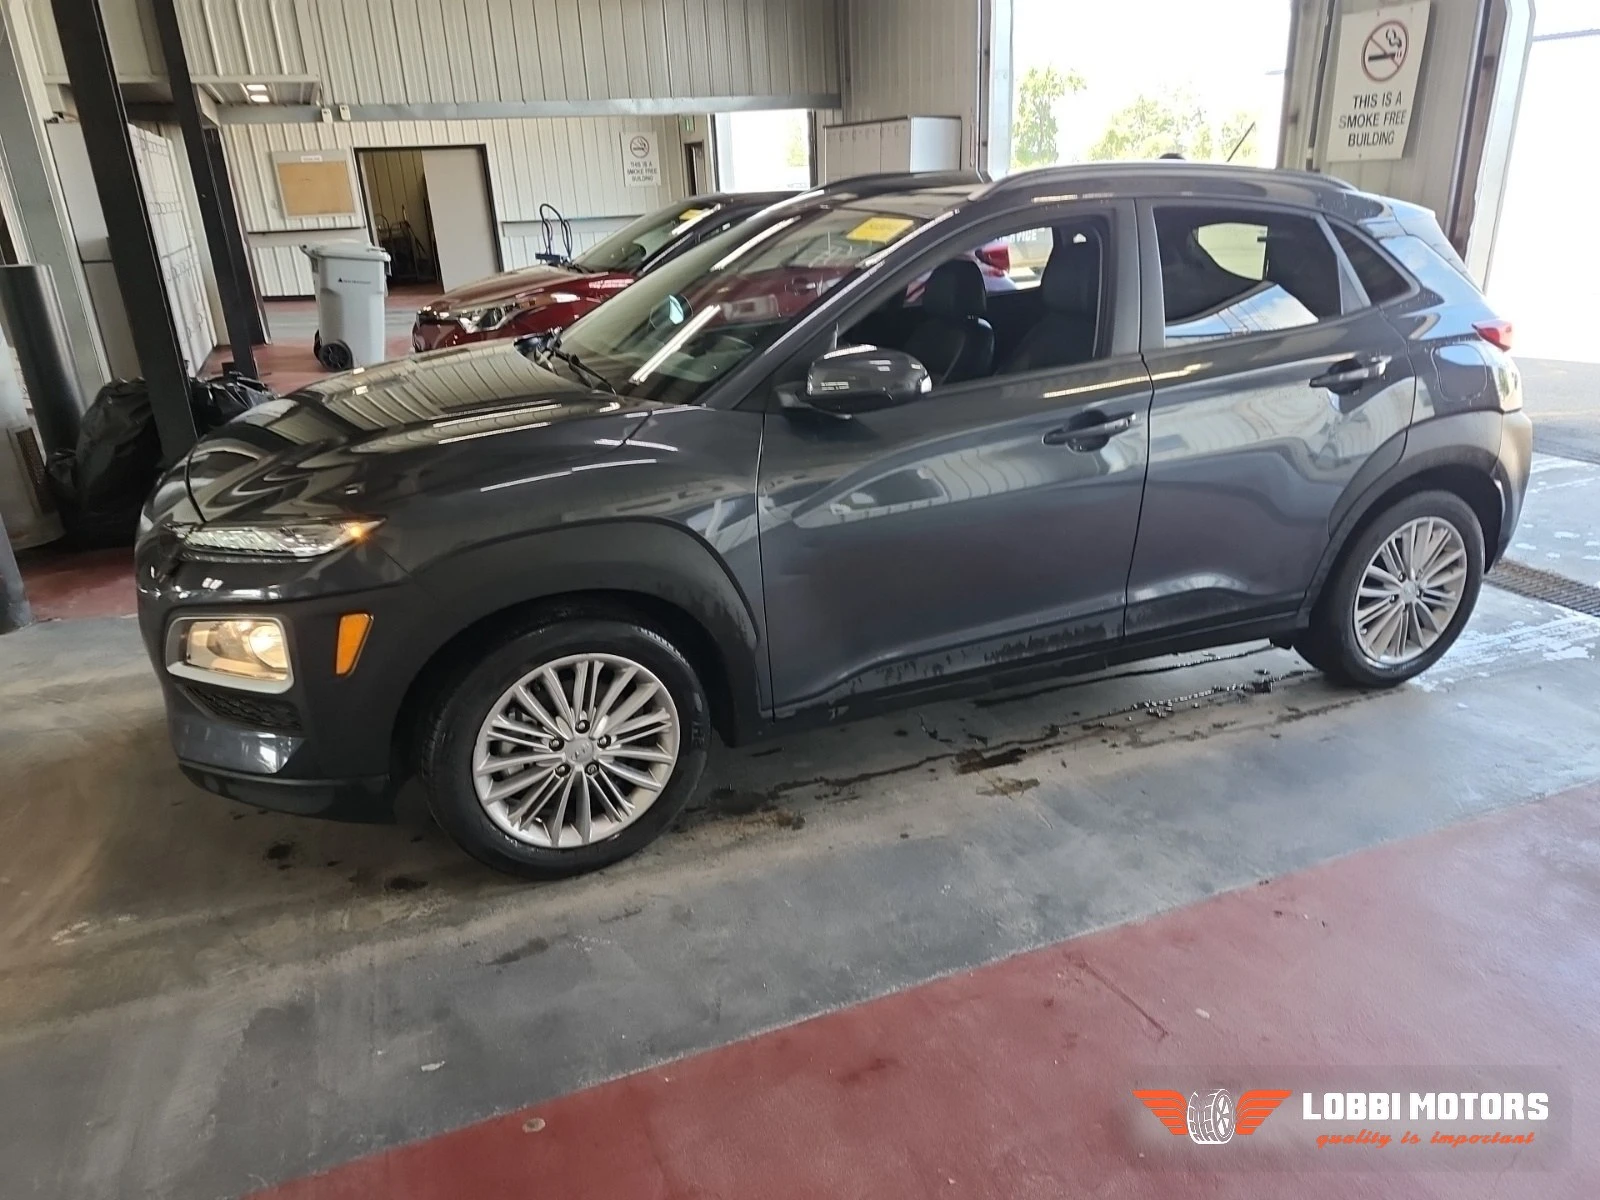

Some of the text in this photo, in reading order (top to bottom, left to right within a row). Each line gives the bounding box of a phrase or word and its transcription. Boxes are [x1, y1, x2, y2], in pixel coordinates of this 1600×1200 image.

[1353, 90, 1402, 109] THIS IS A
[1338, 109, 1407, 129] SMOKE FREE
[1347, 130, 1395, 147] BUILDING
